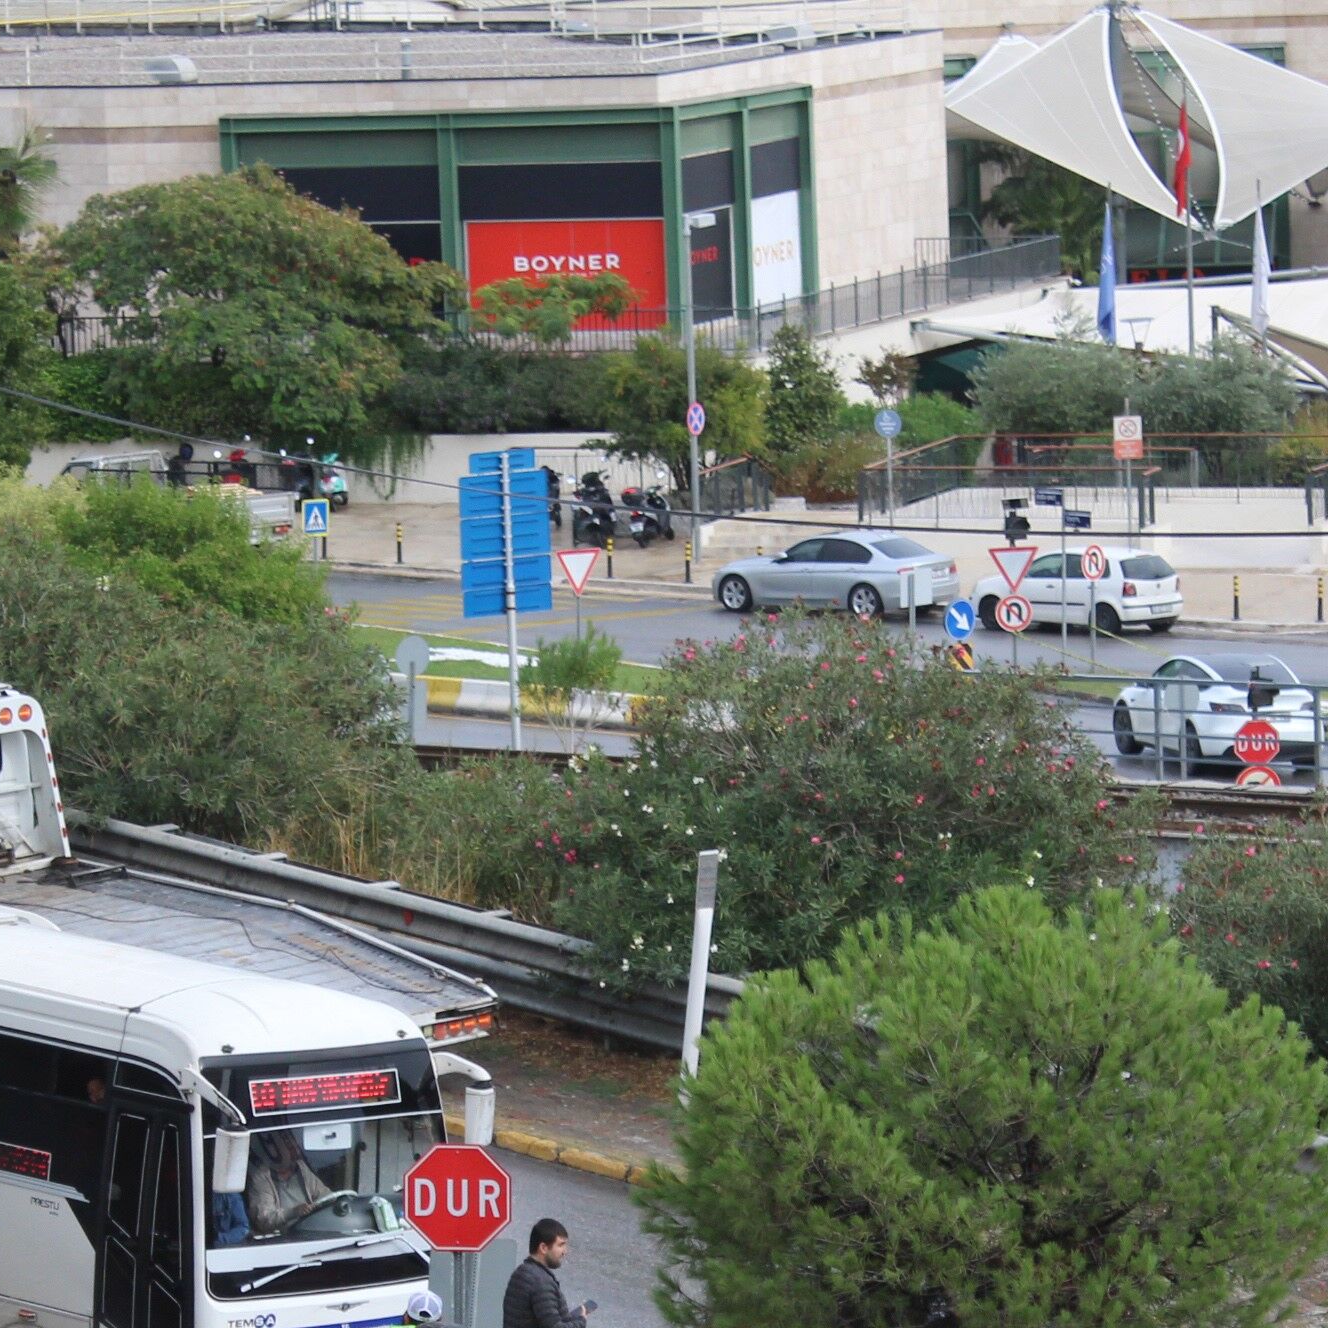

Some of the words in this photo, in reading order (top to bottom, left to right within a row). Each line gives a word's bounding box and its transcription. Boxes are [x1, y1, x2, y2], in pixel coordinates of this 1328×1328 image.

[513, 253, 621, 272] BOYNER
[753, 239, 794, 267] OYNER
[1237, 734, 1276, 752] DUR
[414, 1178, 501, 1218] DUR
